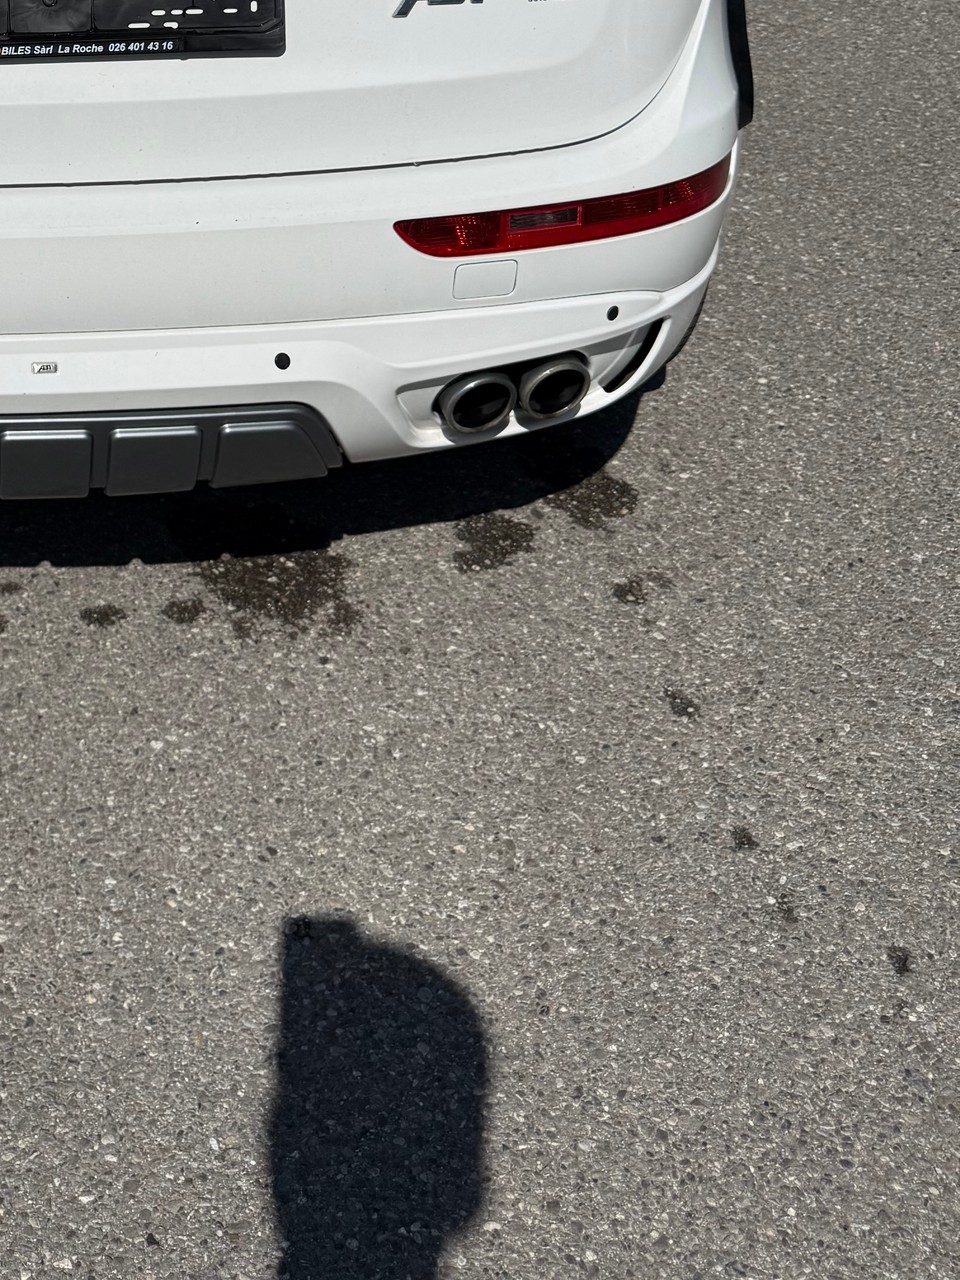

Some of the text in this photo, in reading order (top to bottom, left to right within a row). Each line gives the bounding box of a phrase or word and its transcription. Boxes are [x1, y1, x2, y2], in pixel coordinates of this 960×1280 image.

[58, 45, 70, 54] La
[72, 43, 104, 53] Roche
[108, 42, 126, 52] 026
[127, 42, 145, 51] 401
[147, 41, 159, 51] 43
[161, 41, 173, 50] 16
